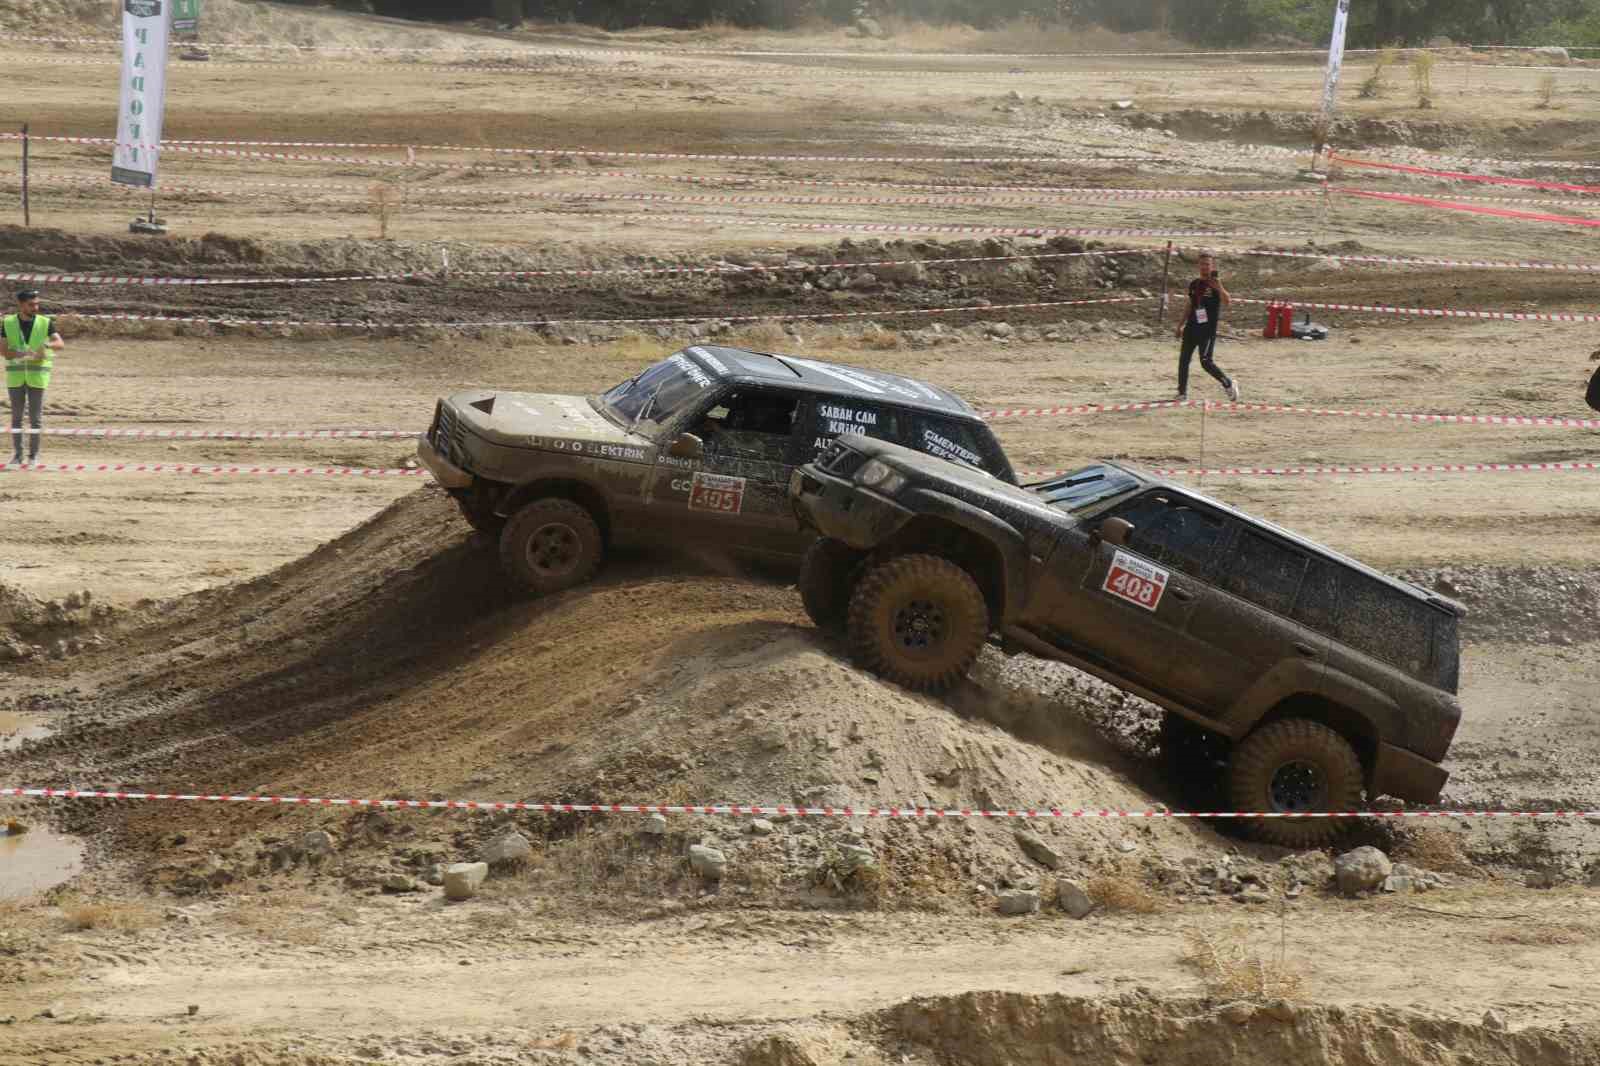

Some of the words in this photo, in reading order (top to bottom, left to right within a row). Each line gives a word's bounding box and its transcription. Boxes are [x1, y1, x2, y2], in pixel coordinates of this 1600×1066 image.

[820, 405, 853, 421] SABAH
[855, 411, 877, 425] CAM
[1113, 573, 1154, 602] 408
